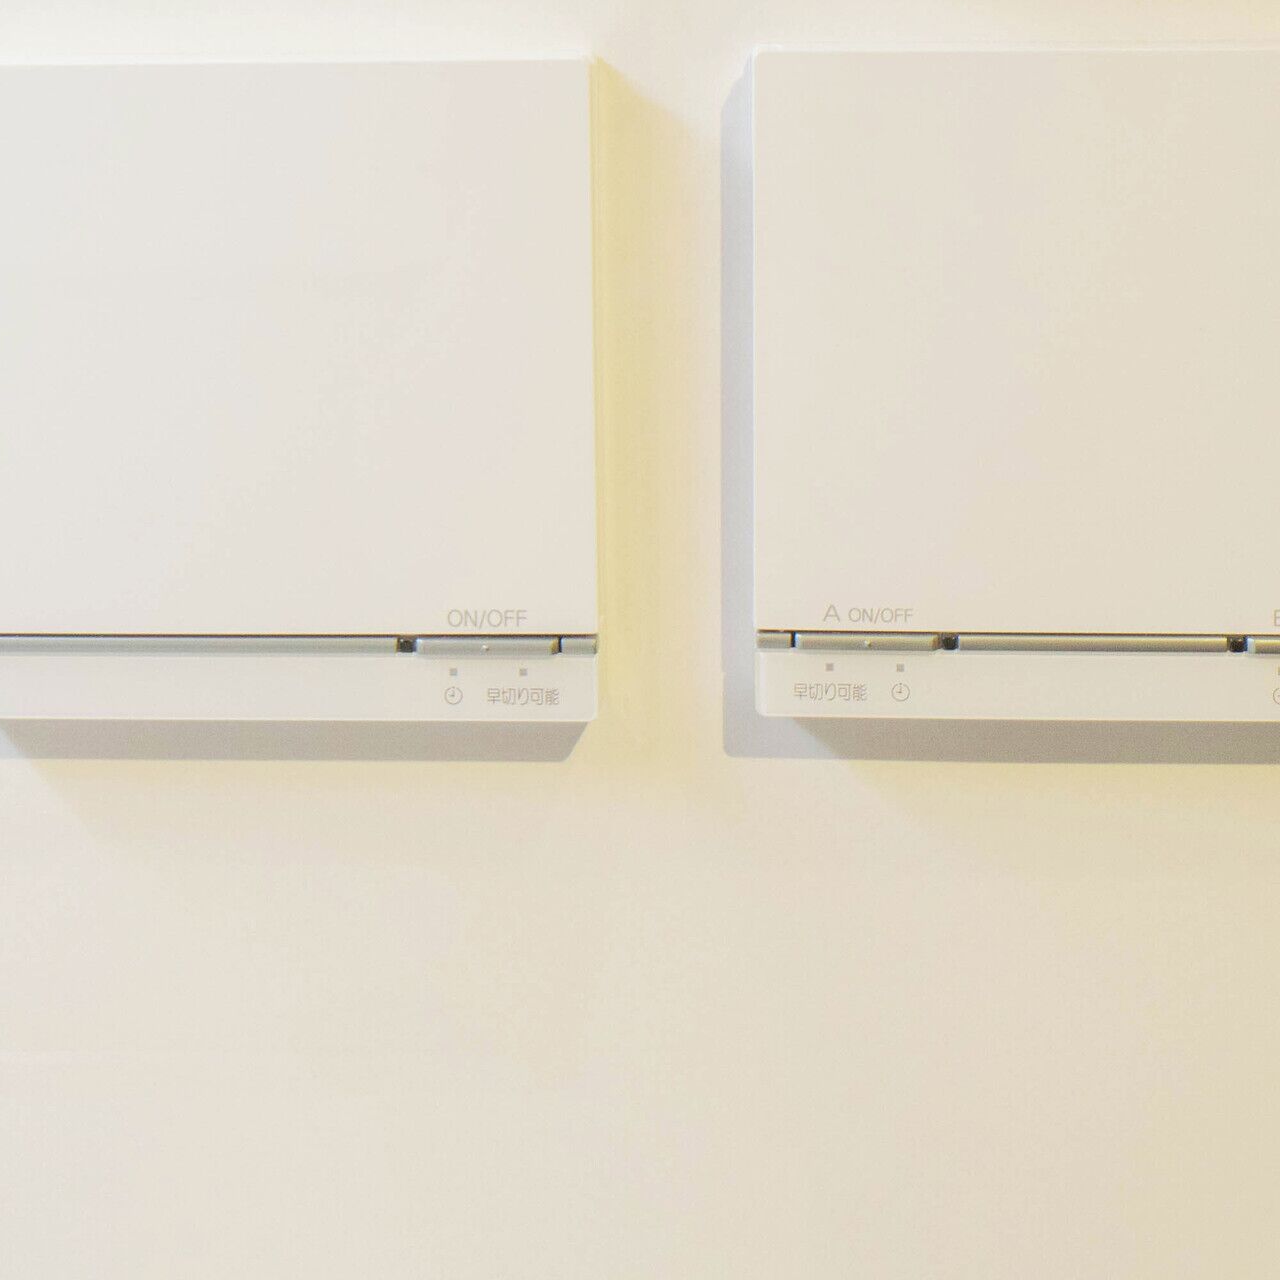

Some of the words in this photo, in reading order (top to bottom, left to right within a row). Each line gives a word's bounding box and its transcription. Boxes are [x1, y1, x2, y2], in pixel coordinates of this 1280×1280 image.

[447, 609, 527, 629] ON/OFF
[822, 604, 841, 623] A
[848, 607, 914, 625] ON/OFF
